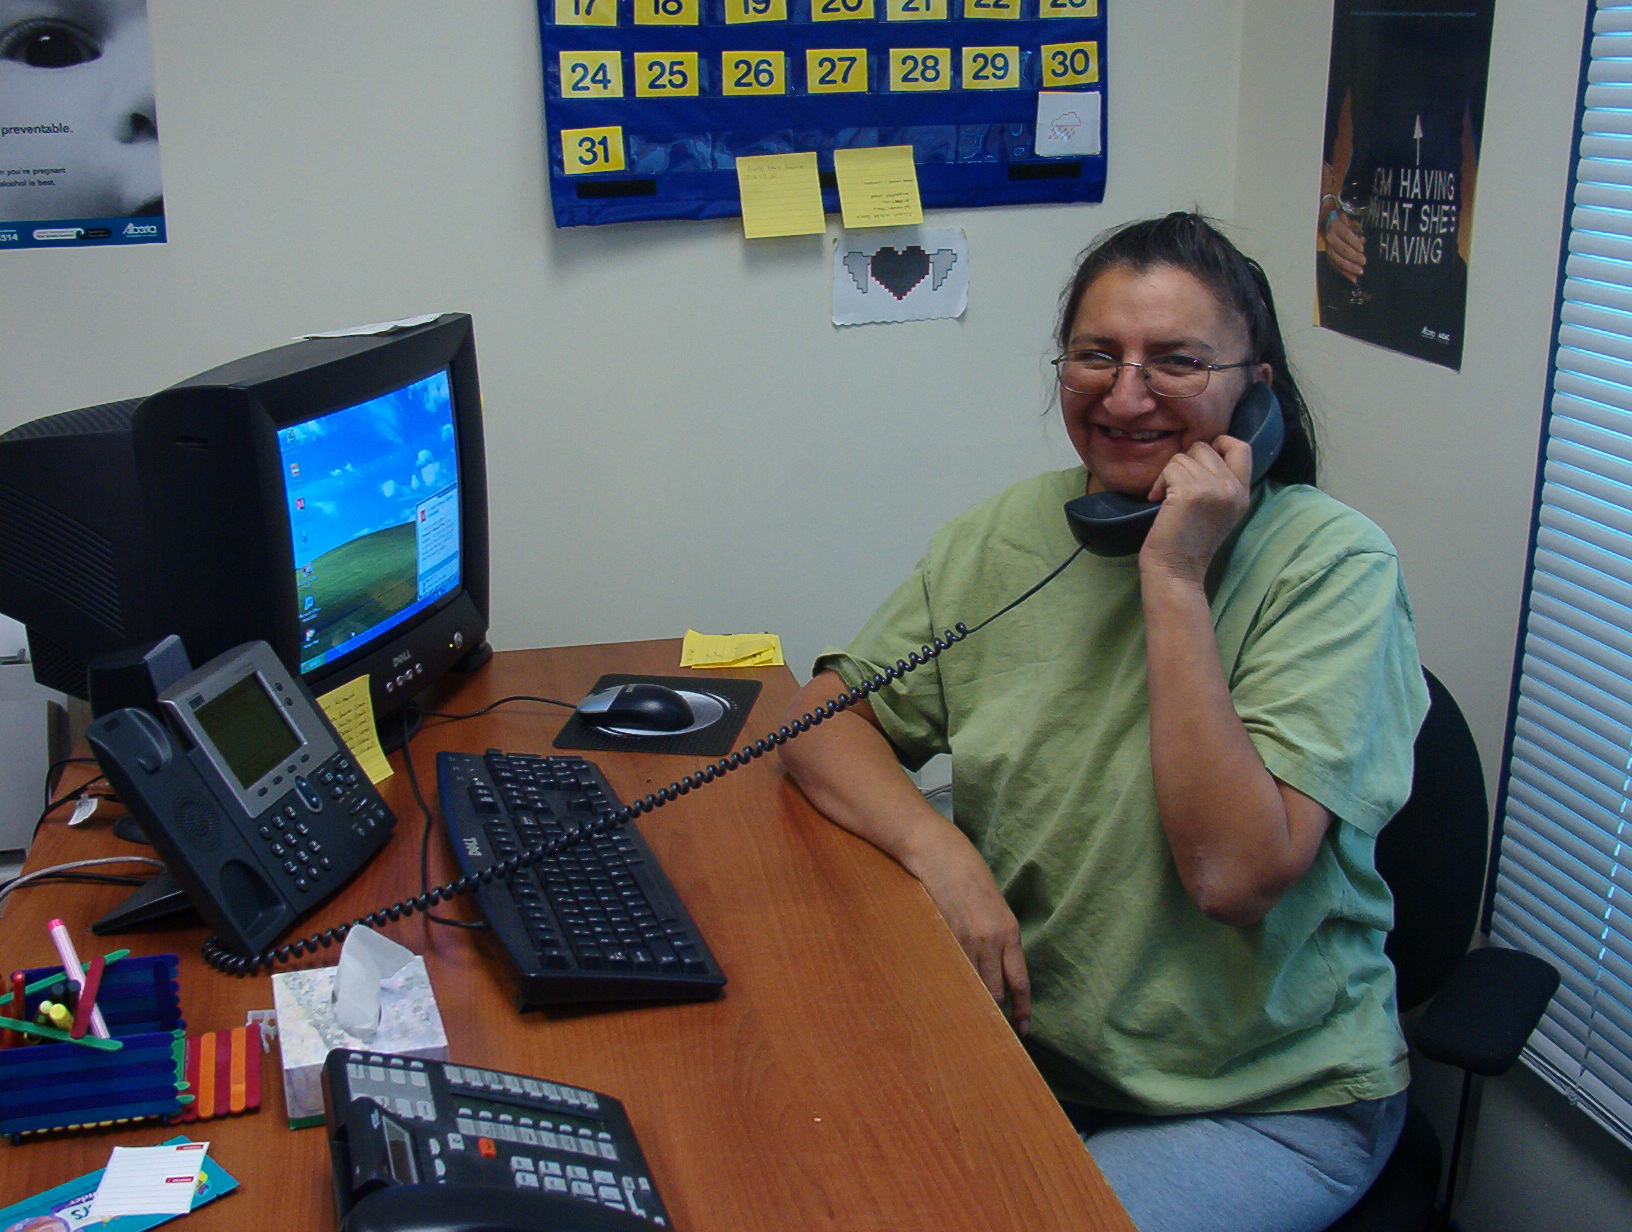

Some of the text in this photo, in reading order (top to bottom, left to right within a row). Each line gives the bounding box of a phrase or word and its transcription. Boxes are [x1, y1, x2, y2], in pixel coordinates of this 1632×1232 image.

[570, 48, 1091, 92] 24 25 26 27 28 29 30
[1, 123, 74, 137] preventable.
[577, 135, 610, 166] 31
[1399, 168, 1456, 202] HAVING
[1379, 232, 1444, 265] HAVING
